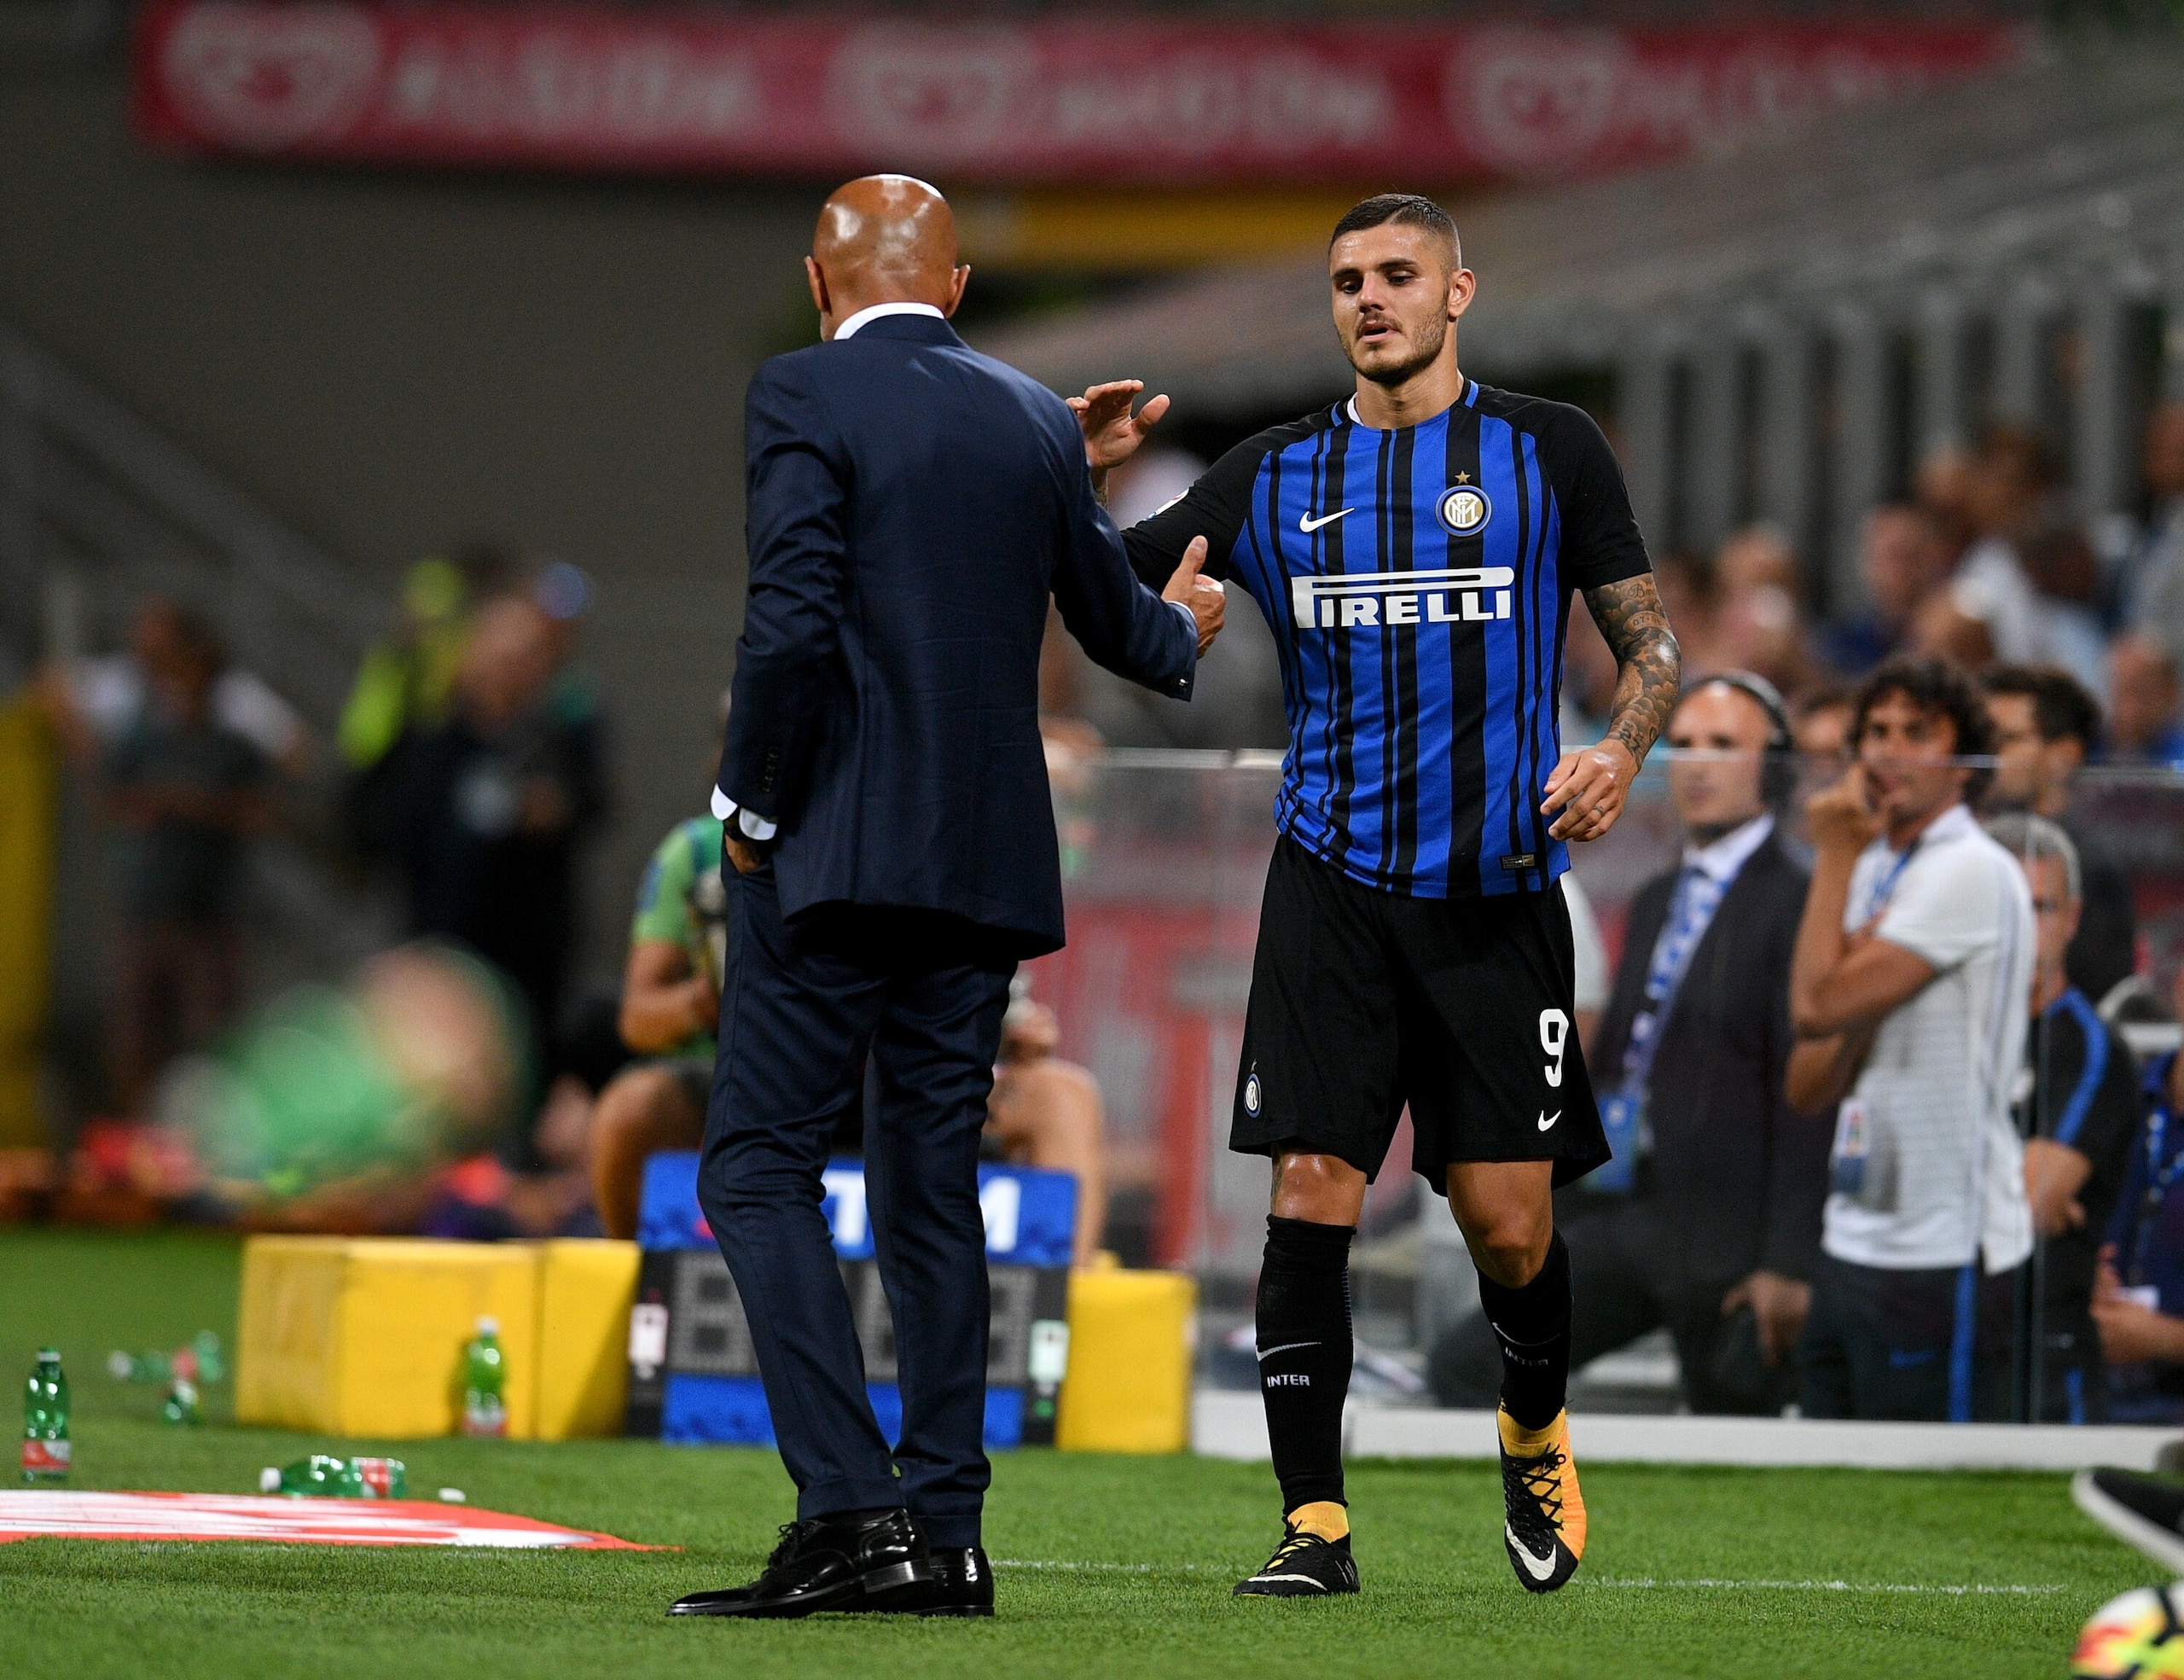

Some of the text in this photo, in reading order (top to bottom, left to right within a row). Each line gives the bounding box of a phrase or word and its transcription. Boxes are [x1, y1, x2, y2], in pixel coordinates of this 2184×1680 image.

[1290, 566, 1515, 629] PIRELLI
[1539, 1009, 1569, 1087] 9
[1267, 1374, 1310, 1388] INTER
